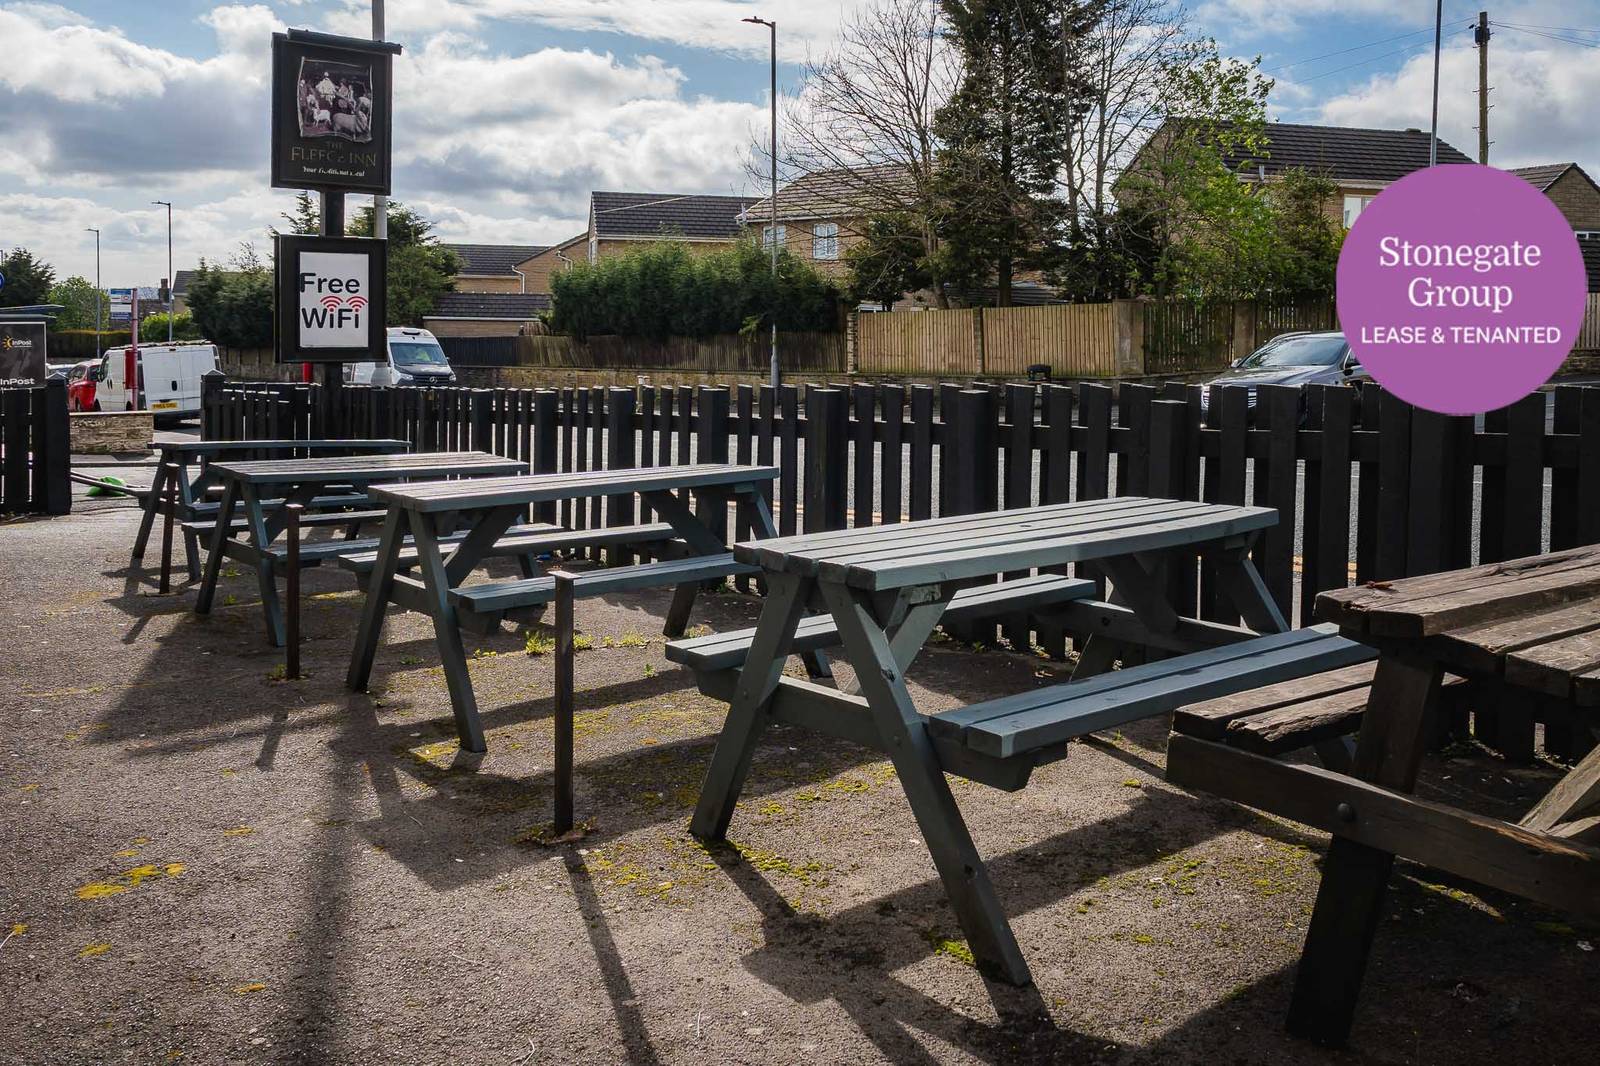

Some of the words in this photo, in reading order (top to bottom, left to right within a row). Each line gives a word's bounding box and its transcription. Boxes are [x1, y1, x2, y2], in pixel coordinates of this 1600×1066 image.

[349, 152, 376, 167] INN
[300, 272, 360, 293] Free
[301, 308, 359, 329] WiFi
